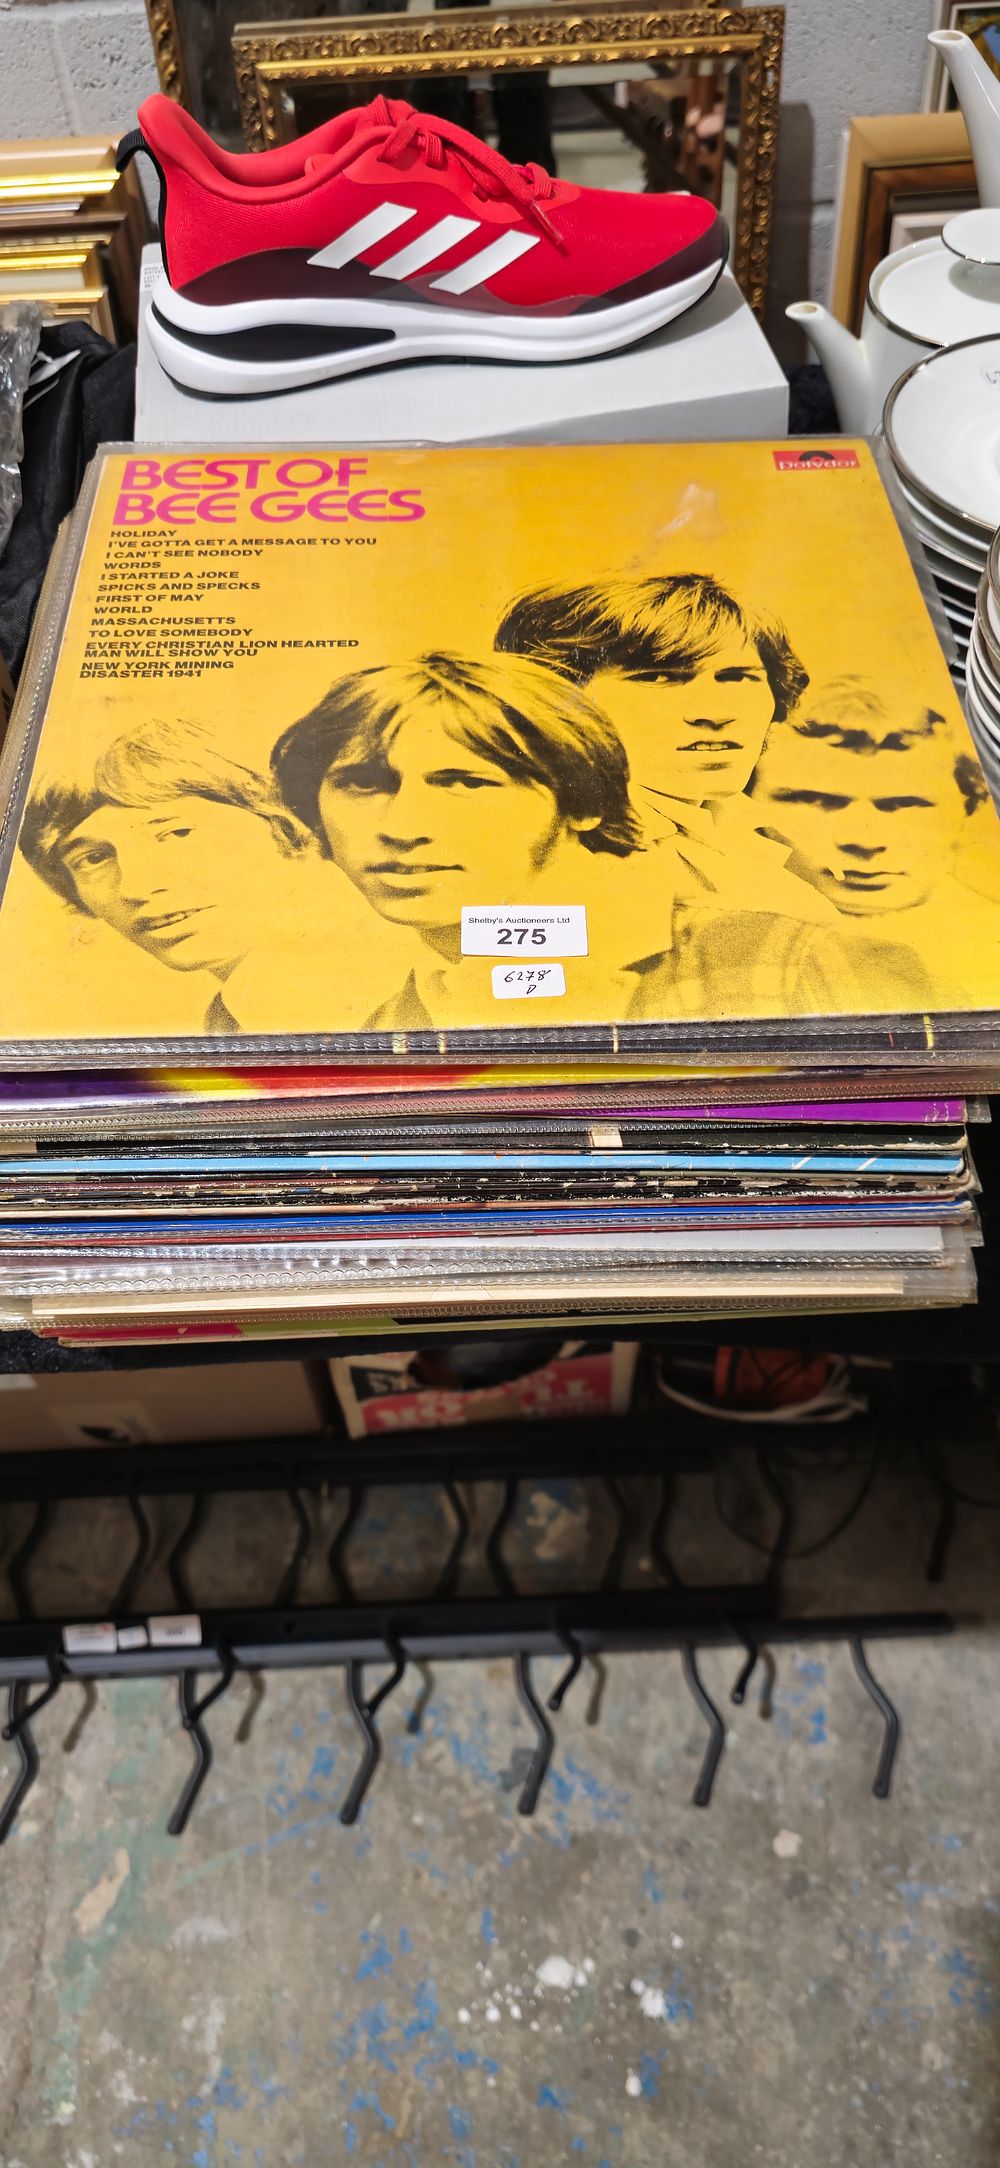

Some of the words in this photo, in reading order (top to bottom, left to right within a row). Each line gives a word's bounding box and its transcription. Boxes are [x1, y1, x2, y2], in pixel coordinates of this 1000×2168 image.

[120, 459, 271, 491] BEST
[276, 458, 368, 489] OF
[112, 492, 240, 526] BEE
[250, 489, 426, 523] GEES
[111, 530, 177, 538] HOLIDAY
[108, 541, 138, 549] I'VE
[141, 540, 191, 548] GOTTA
[241, 538, 317, 546] MESSAGE
[114, 550, 161, 559] CAN'T
[197, 549, 263, 557] NOBODY
[104, 561, 161, 570] WORDS
[108, 572, 180, 581] STARTED
[183, 571, 194, 579] A
[197, 571, 239, 579] JOKE
[98, 583, 156, 592] SPICKS
[160, 582, 193, 590] AND
[196, 582, 261, 590] SPECKS
[96, 594, 143, 603] FIRST
[145, 594, 167, 602] OF
[170, 594, 204, 602] MAY
[94, 606, 153, 614] WORLD
[91, 617, 236, 626] MASSACHUSETTS
[89, 629, 111, 638] TO
[113, 629, 157, 637] LOVE
[160, 628, 253, 637] SOMEBODY
[86, 641, 143, 650] EVERY
[145, 641, 234, 649] CHRISTIAN
[239, 640, 278, 648] LION
[281, 640, 359, 648] HEARTED
[84, 650, 121, 658] MAN
[125, 649, 165, 658] WILL
[168, 649, 219, 657] SHOW
[223, 648, 258, 657] YOU
[81, 662, 120, 670] NEW
[124, 661, 170, 670] YORK
[174, 661, 234, 669] MINING
[79, 670, 163, 679] DISASTER
[166, 670, 202, 678] 1941
[468, 917, 503, 925] Shelby's
[497, 928, 547, 945] 275
